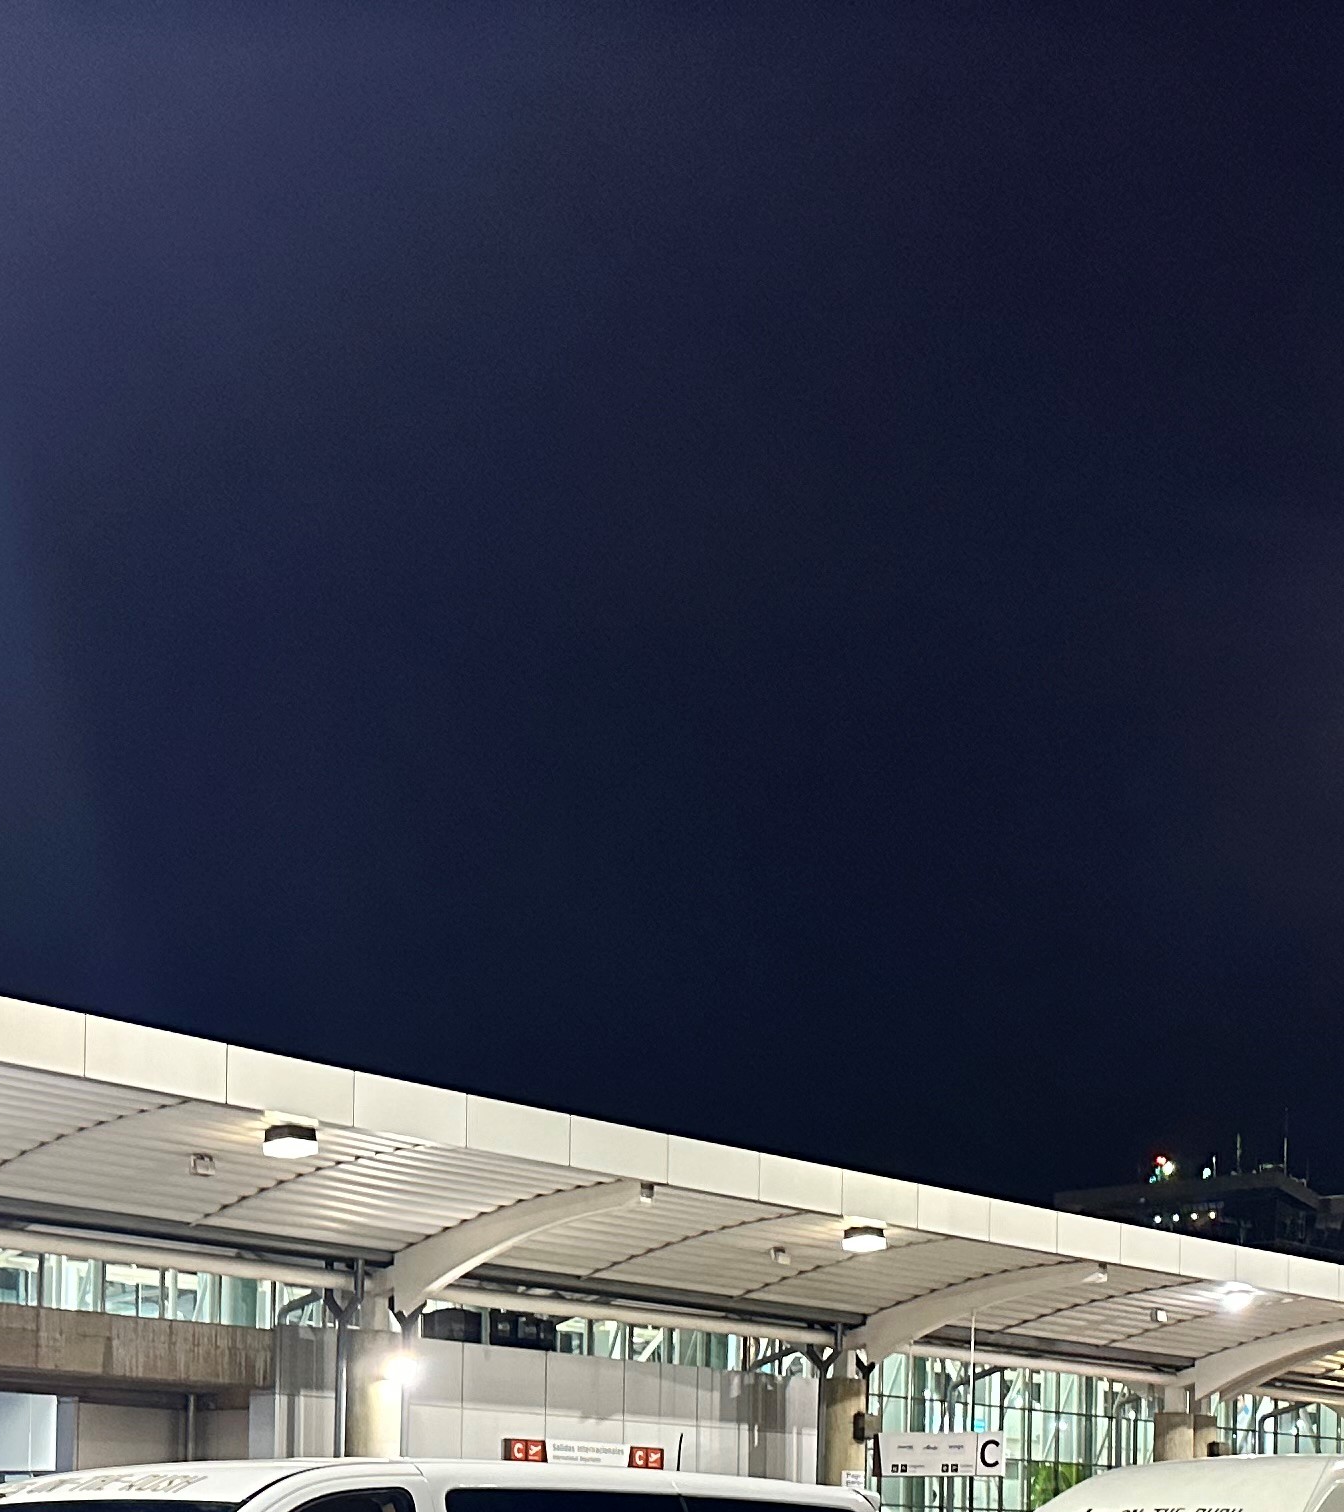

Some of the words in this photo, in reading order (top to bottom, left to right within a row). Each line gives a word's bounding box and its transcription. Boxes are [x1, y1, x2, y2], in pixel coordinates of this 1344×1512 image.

[513, 1442, 524, 1459] C
[635, 1450, 644, 1466] C
[980, 1439, 1001, 1468] C
